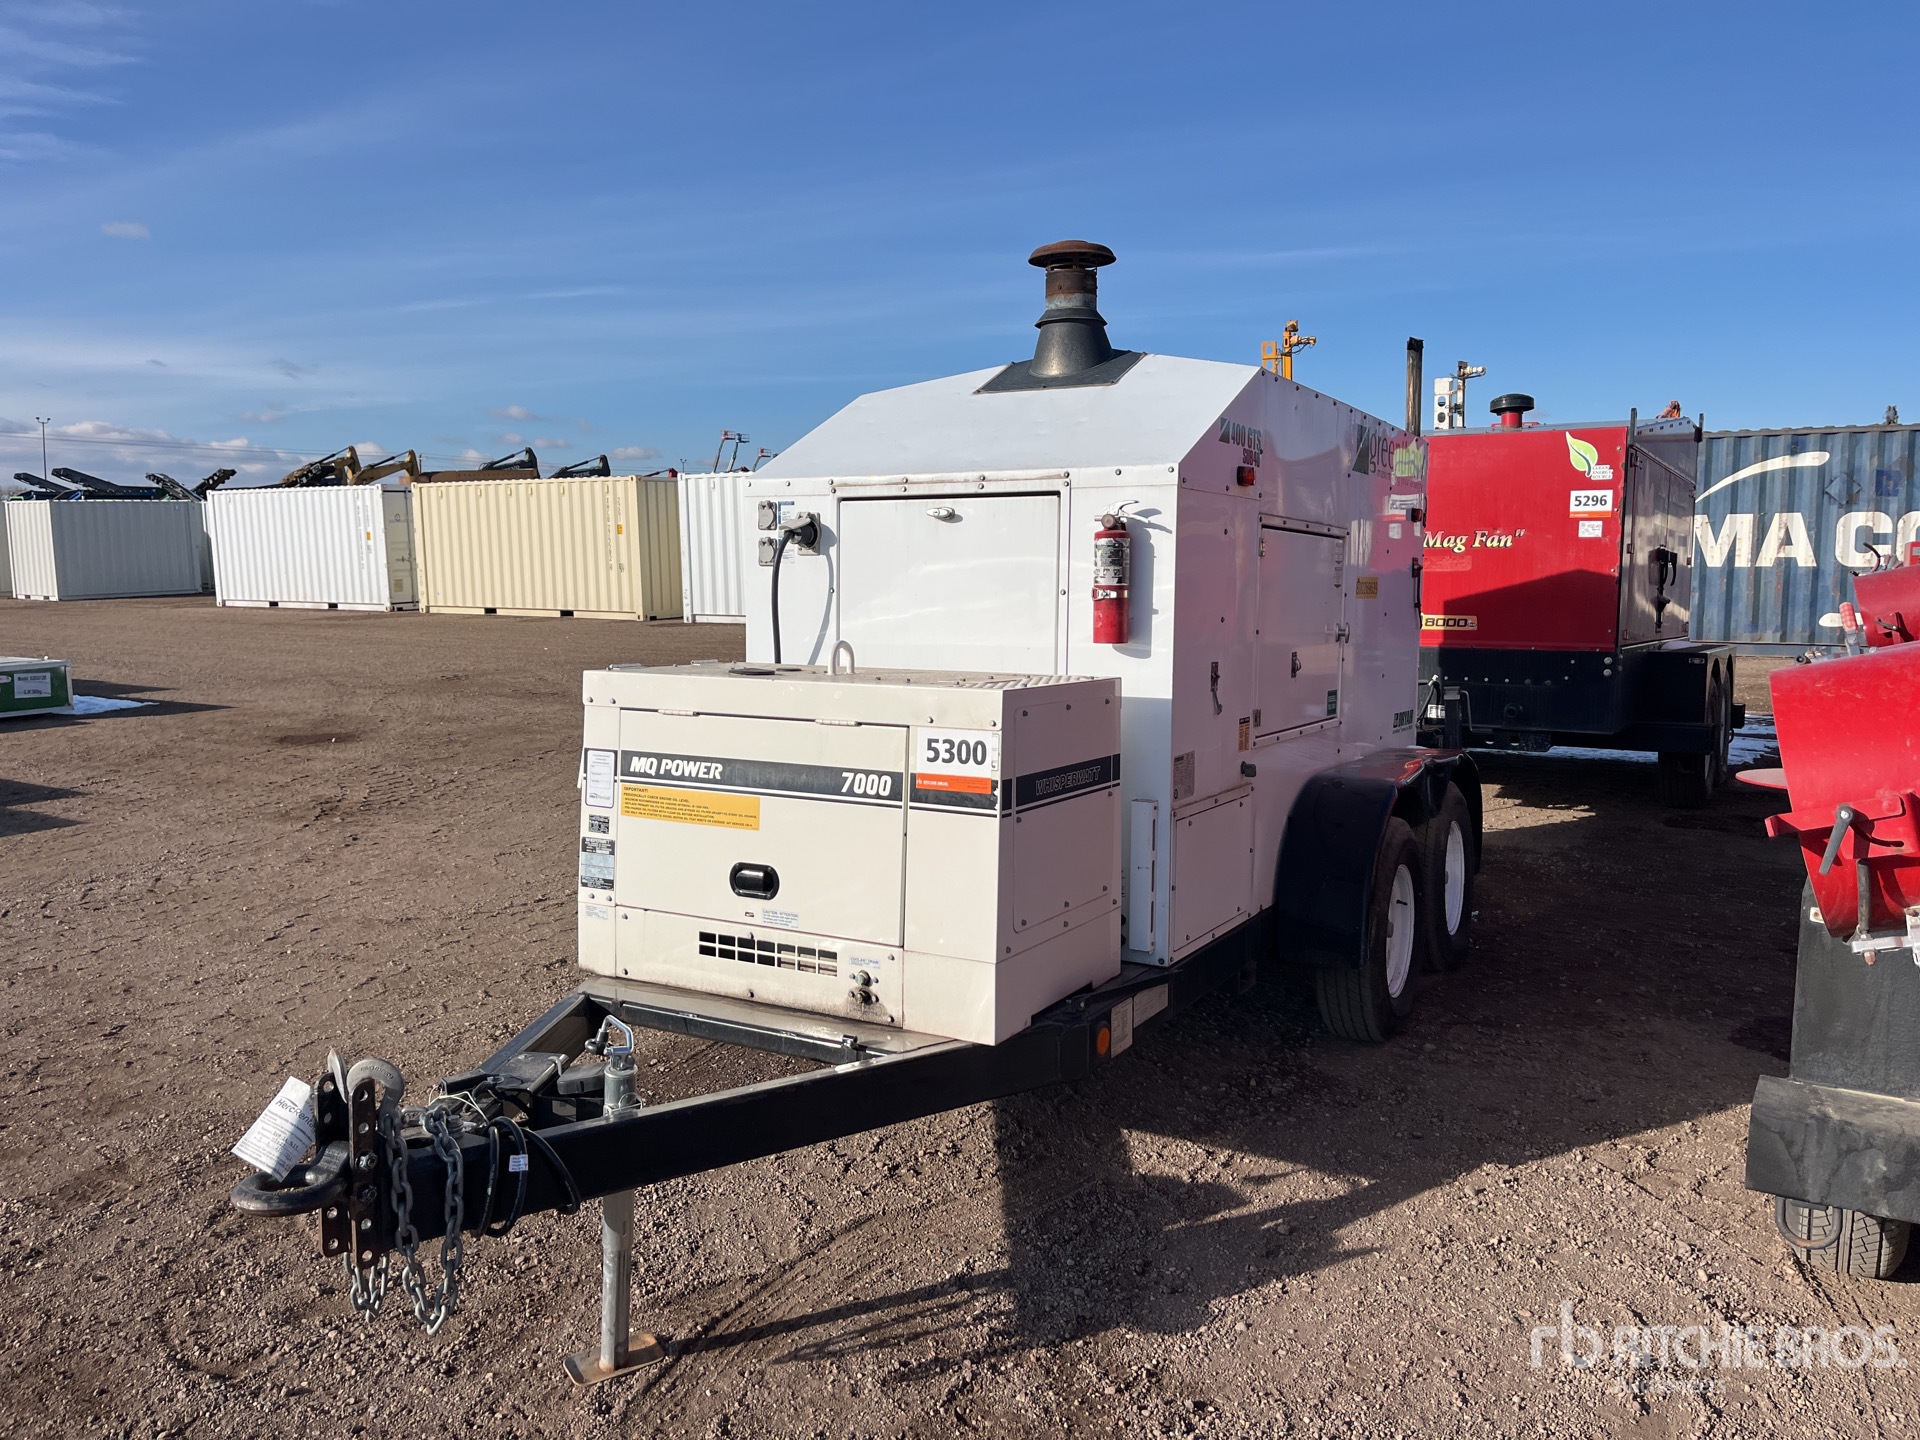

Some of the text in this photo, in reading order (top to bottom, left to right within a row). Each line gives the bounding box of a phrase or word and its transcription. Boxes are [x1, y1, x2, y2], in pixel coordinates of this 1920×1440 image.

[1574, 495, 1608, 507] 5296
[1423, 530, 1468, 553] Mag
[1425, 617, 1468, 628] 8000
[926, 738, 987, 766] 5300
[630, 756, 658, 777] MQ
[659, 758, 723, 780] POWER
[1035, 765, 1101, 796] WHISPERWATT
[840, 771, 892, 797] 7000
[276, 1098, 317, 1132] HercRenta
